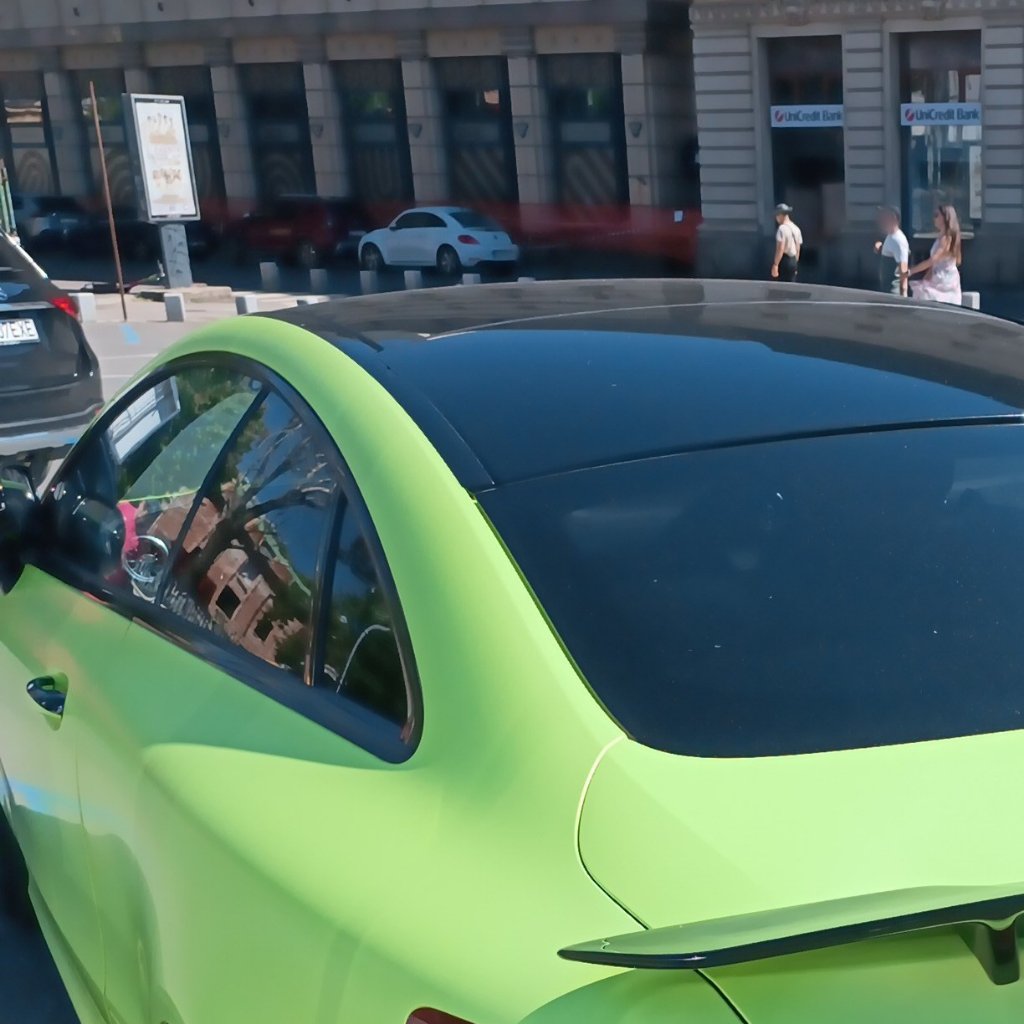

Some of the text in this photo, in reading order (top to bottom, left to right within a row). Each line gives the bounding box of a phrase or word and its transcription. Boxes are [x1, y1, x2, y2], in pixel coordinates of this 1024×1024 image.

[785, 110, 820, 122] UniCredit
[915, 107, 979, 121] UniCredit Bank
